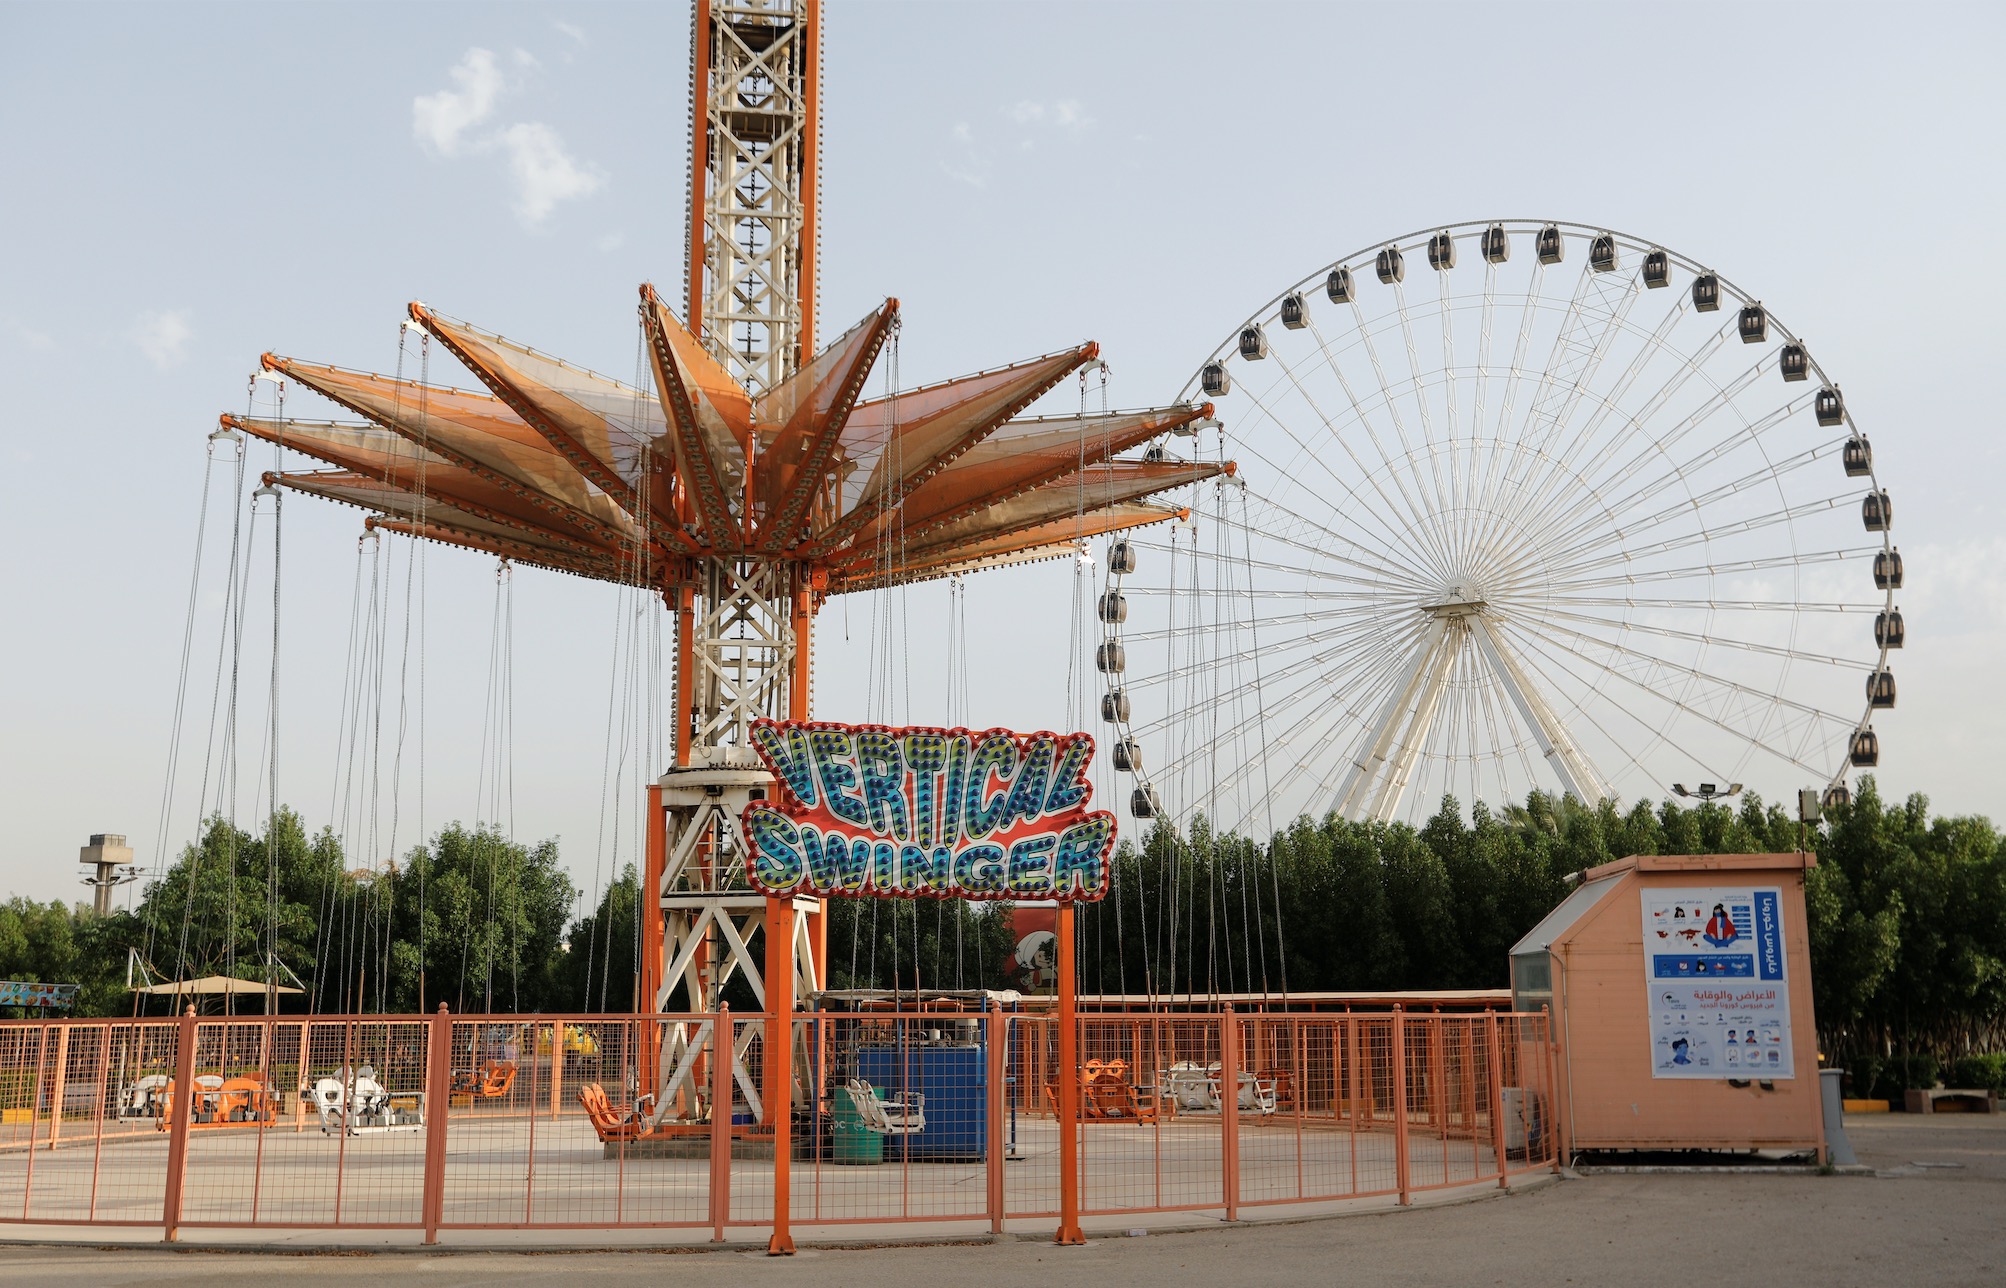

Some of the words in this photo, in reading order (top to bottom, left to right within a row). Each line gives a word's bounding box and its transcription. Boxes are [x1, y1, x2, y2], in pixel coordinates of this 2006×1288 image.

[757, 727, 1090, 849] VERTICAL
[752, 808, 1110, 892] SWINGER
[1762, 898, 1774, 931] كورونا
[1764, 933, 1778, 974] فايروس
[1694, 990, 1733, 1002] والوقاية
[1736, 989, 1776, 1002] الأعراض
